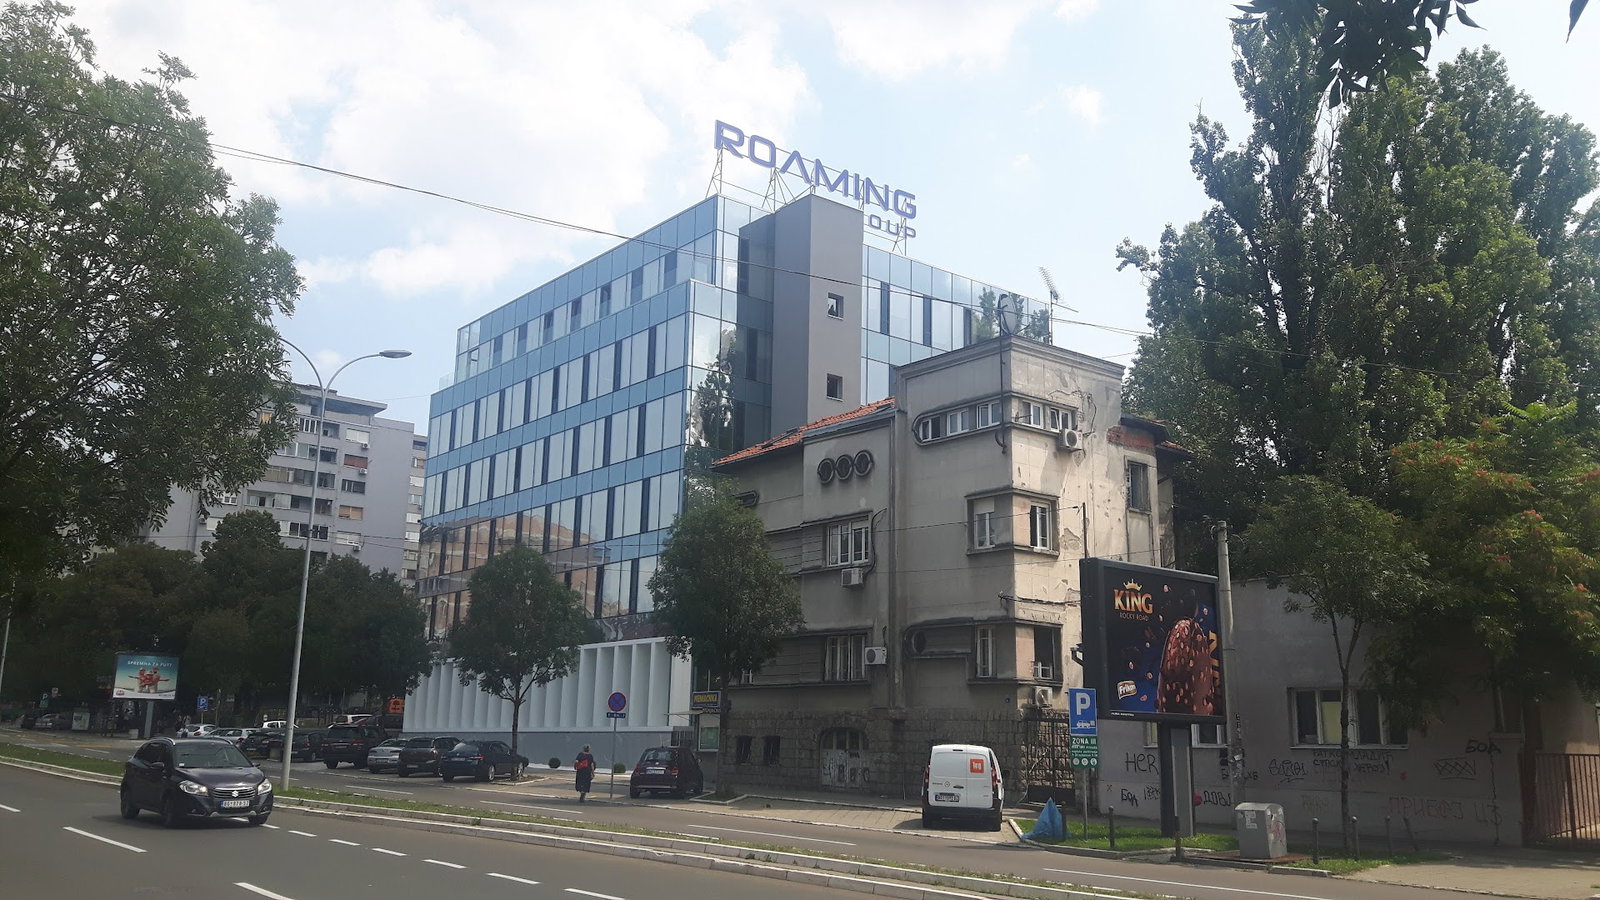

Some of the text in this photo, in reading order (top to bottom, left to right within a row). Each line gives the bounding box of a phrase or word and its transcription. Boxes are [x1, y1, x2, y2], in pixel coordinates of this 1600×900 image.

[715, 119, 917, 220] ROAMING
[868, 213, 917, 239] OUP
[1113, 588, 1153, 614] KING
[199, 697, 207, 706] P
[1075, 692, 1091, 716] P
[1072, 737, 1090, 745] ZONA
